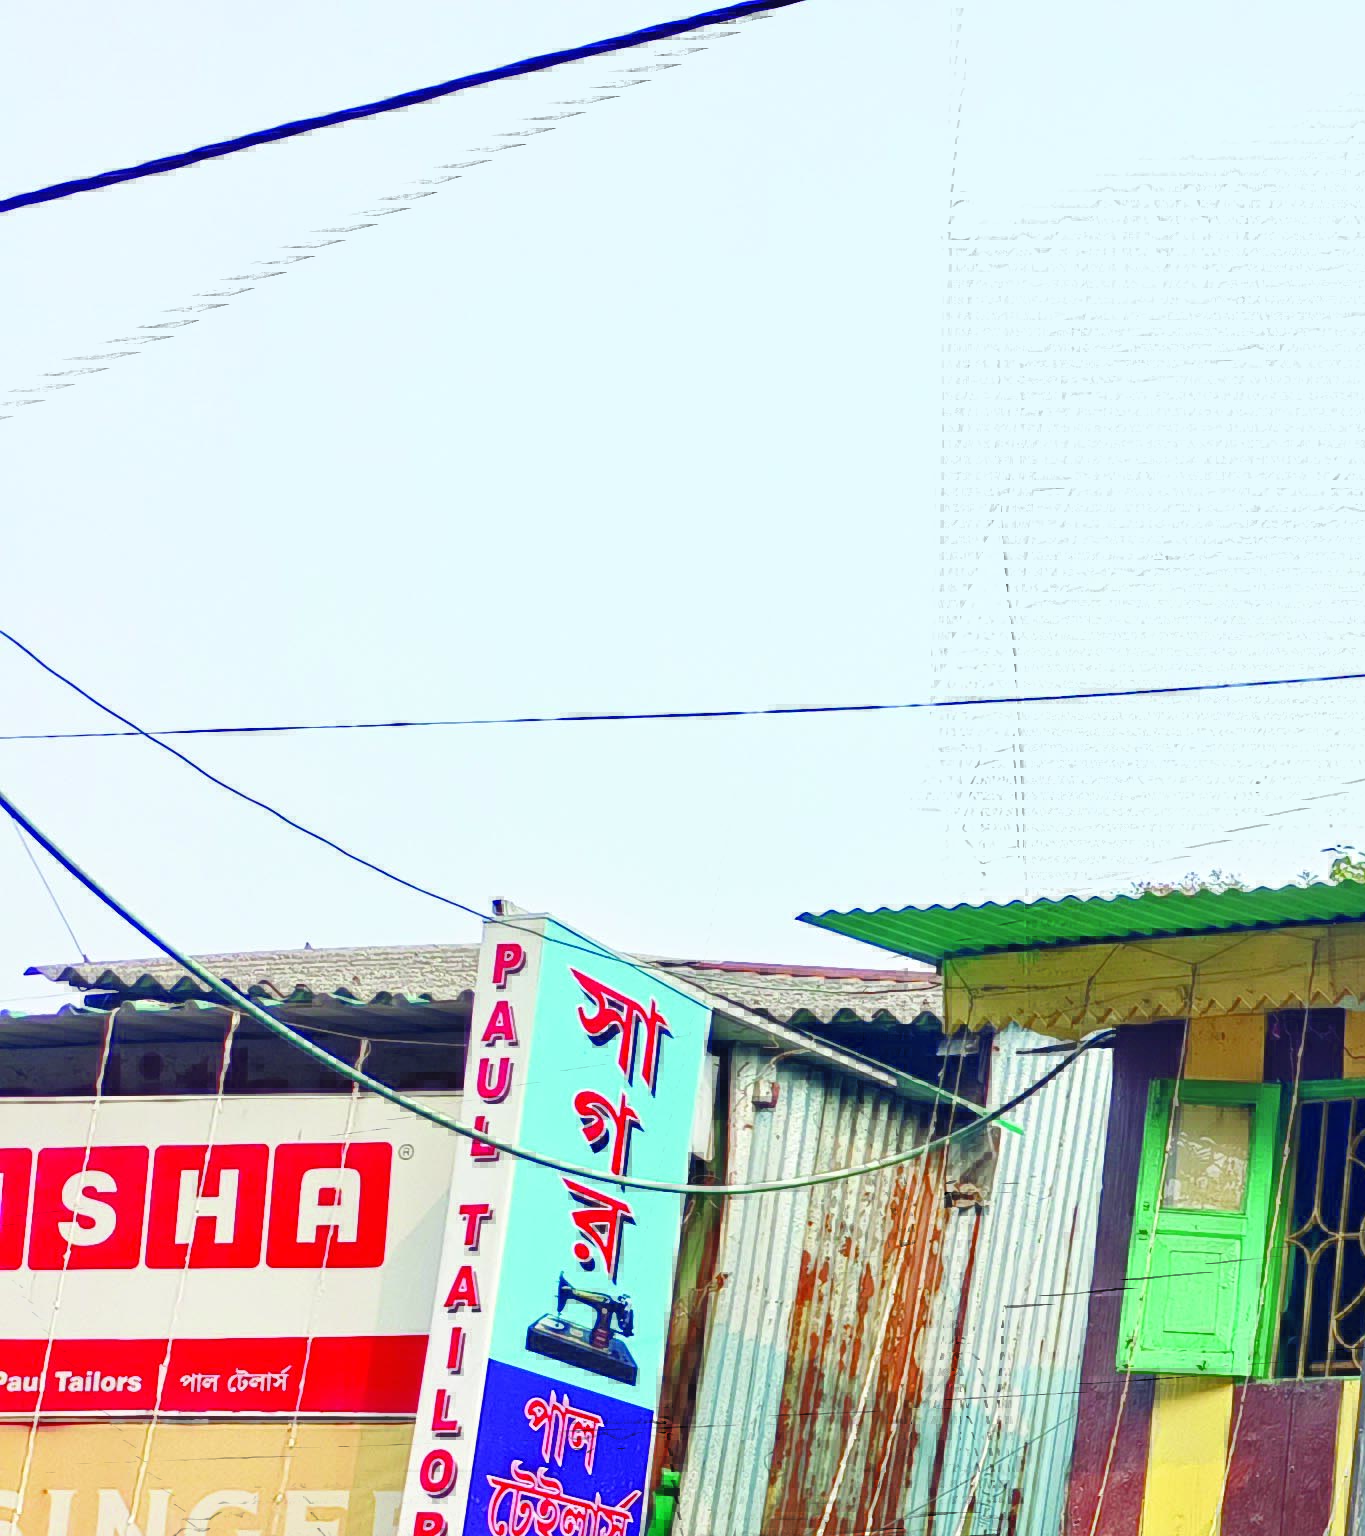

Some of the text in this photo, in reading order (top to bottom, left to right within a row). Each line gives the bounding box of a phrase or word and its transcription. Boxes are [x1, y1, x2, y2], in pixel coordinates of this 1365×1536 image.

[470, 943, 526, 1162] PAUL
[55, 1370, 142, 1393] Tailors
[179, 1365, 293, 1393] পাল টেলার্স
[524, 1390, 604, 1475] পাল
